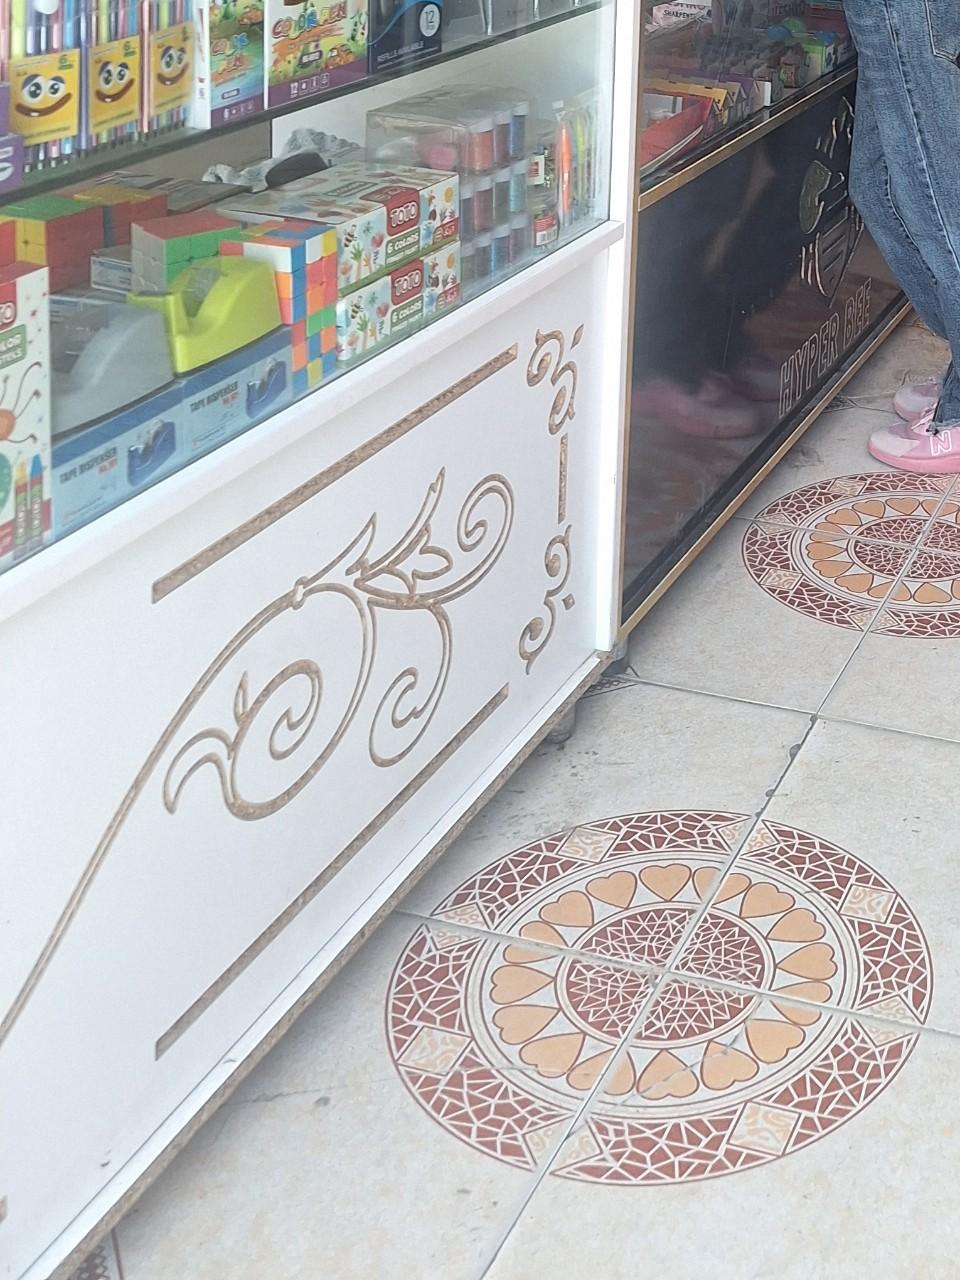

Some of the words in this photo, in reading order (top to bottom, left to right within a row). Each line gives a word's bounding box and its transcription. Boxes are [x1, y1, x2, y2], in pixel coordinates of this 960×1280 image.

[272, 7, 319, 40] COLOR
[320, 0, 348, 26] PEN
[390, 201, 418, 228] TOTO
[394, 232, 419, 251] COLORS
[394, 269, 422, 297] TOTO
[778, 312, 840, 419] HYPER
[843, 277, 872, 350] BEE
